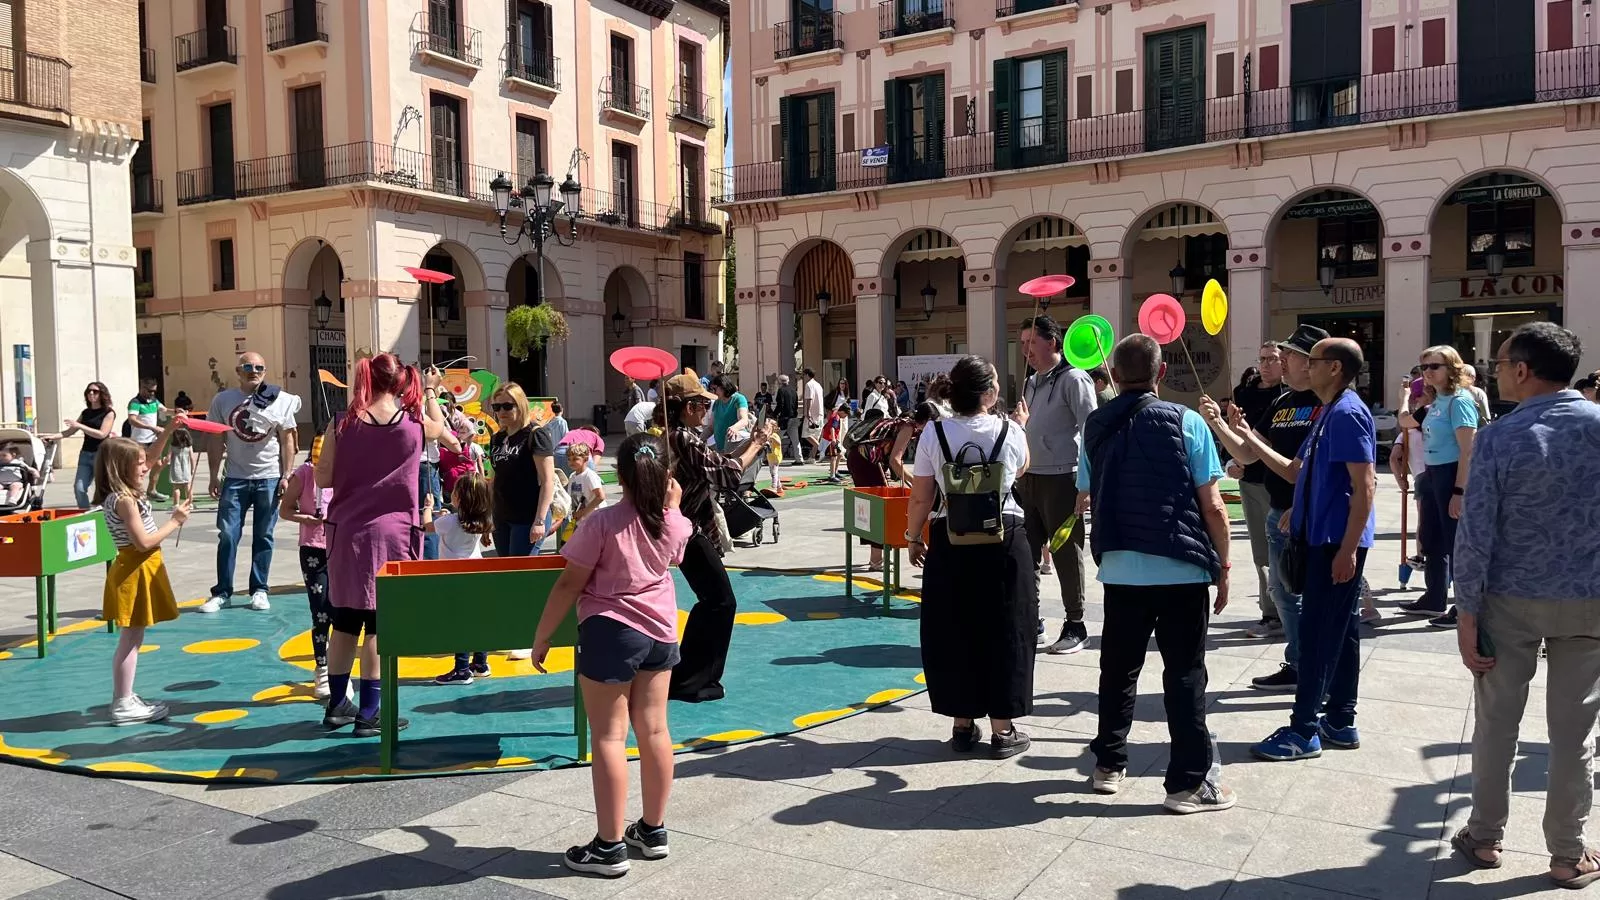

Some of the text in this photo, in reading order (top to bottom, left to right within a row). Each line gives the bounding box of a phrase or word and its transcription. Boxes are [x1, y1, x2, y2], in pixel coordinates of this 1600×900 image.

[1493, 188, 1502, 200] LA
[1504, 183, 1542, 199] CONFIANZA
[1460, 277, 1497, 298] LA
